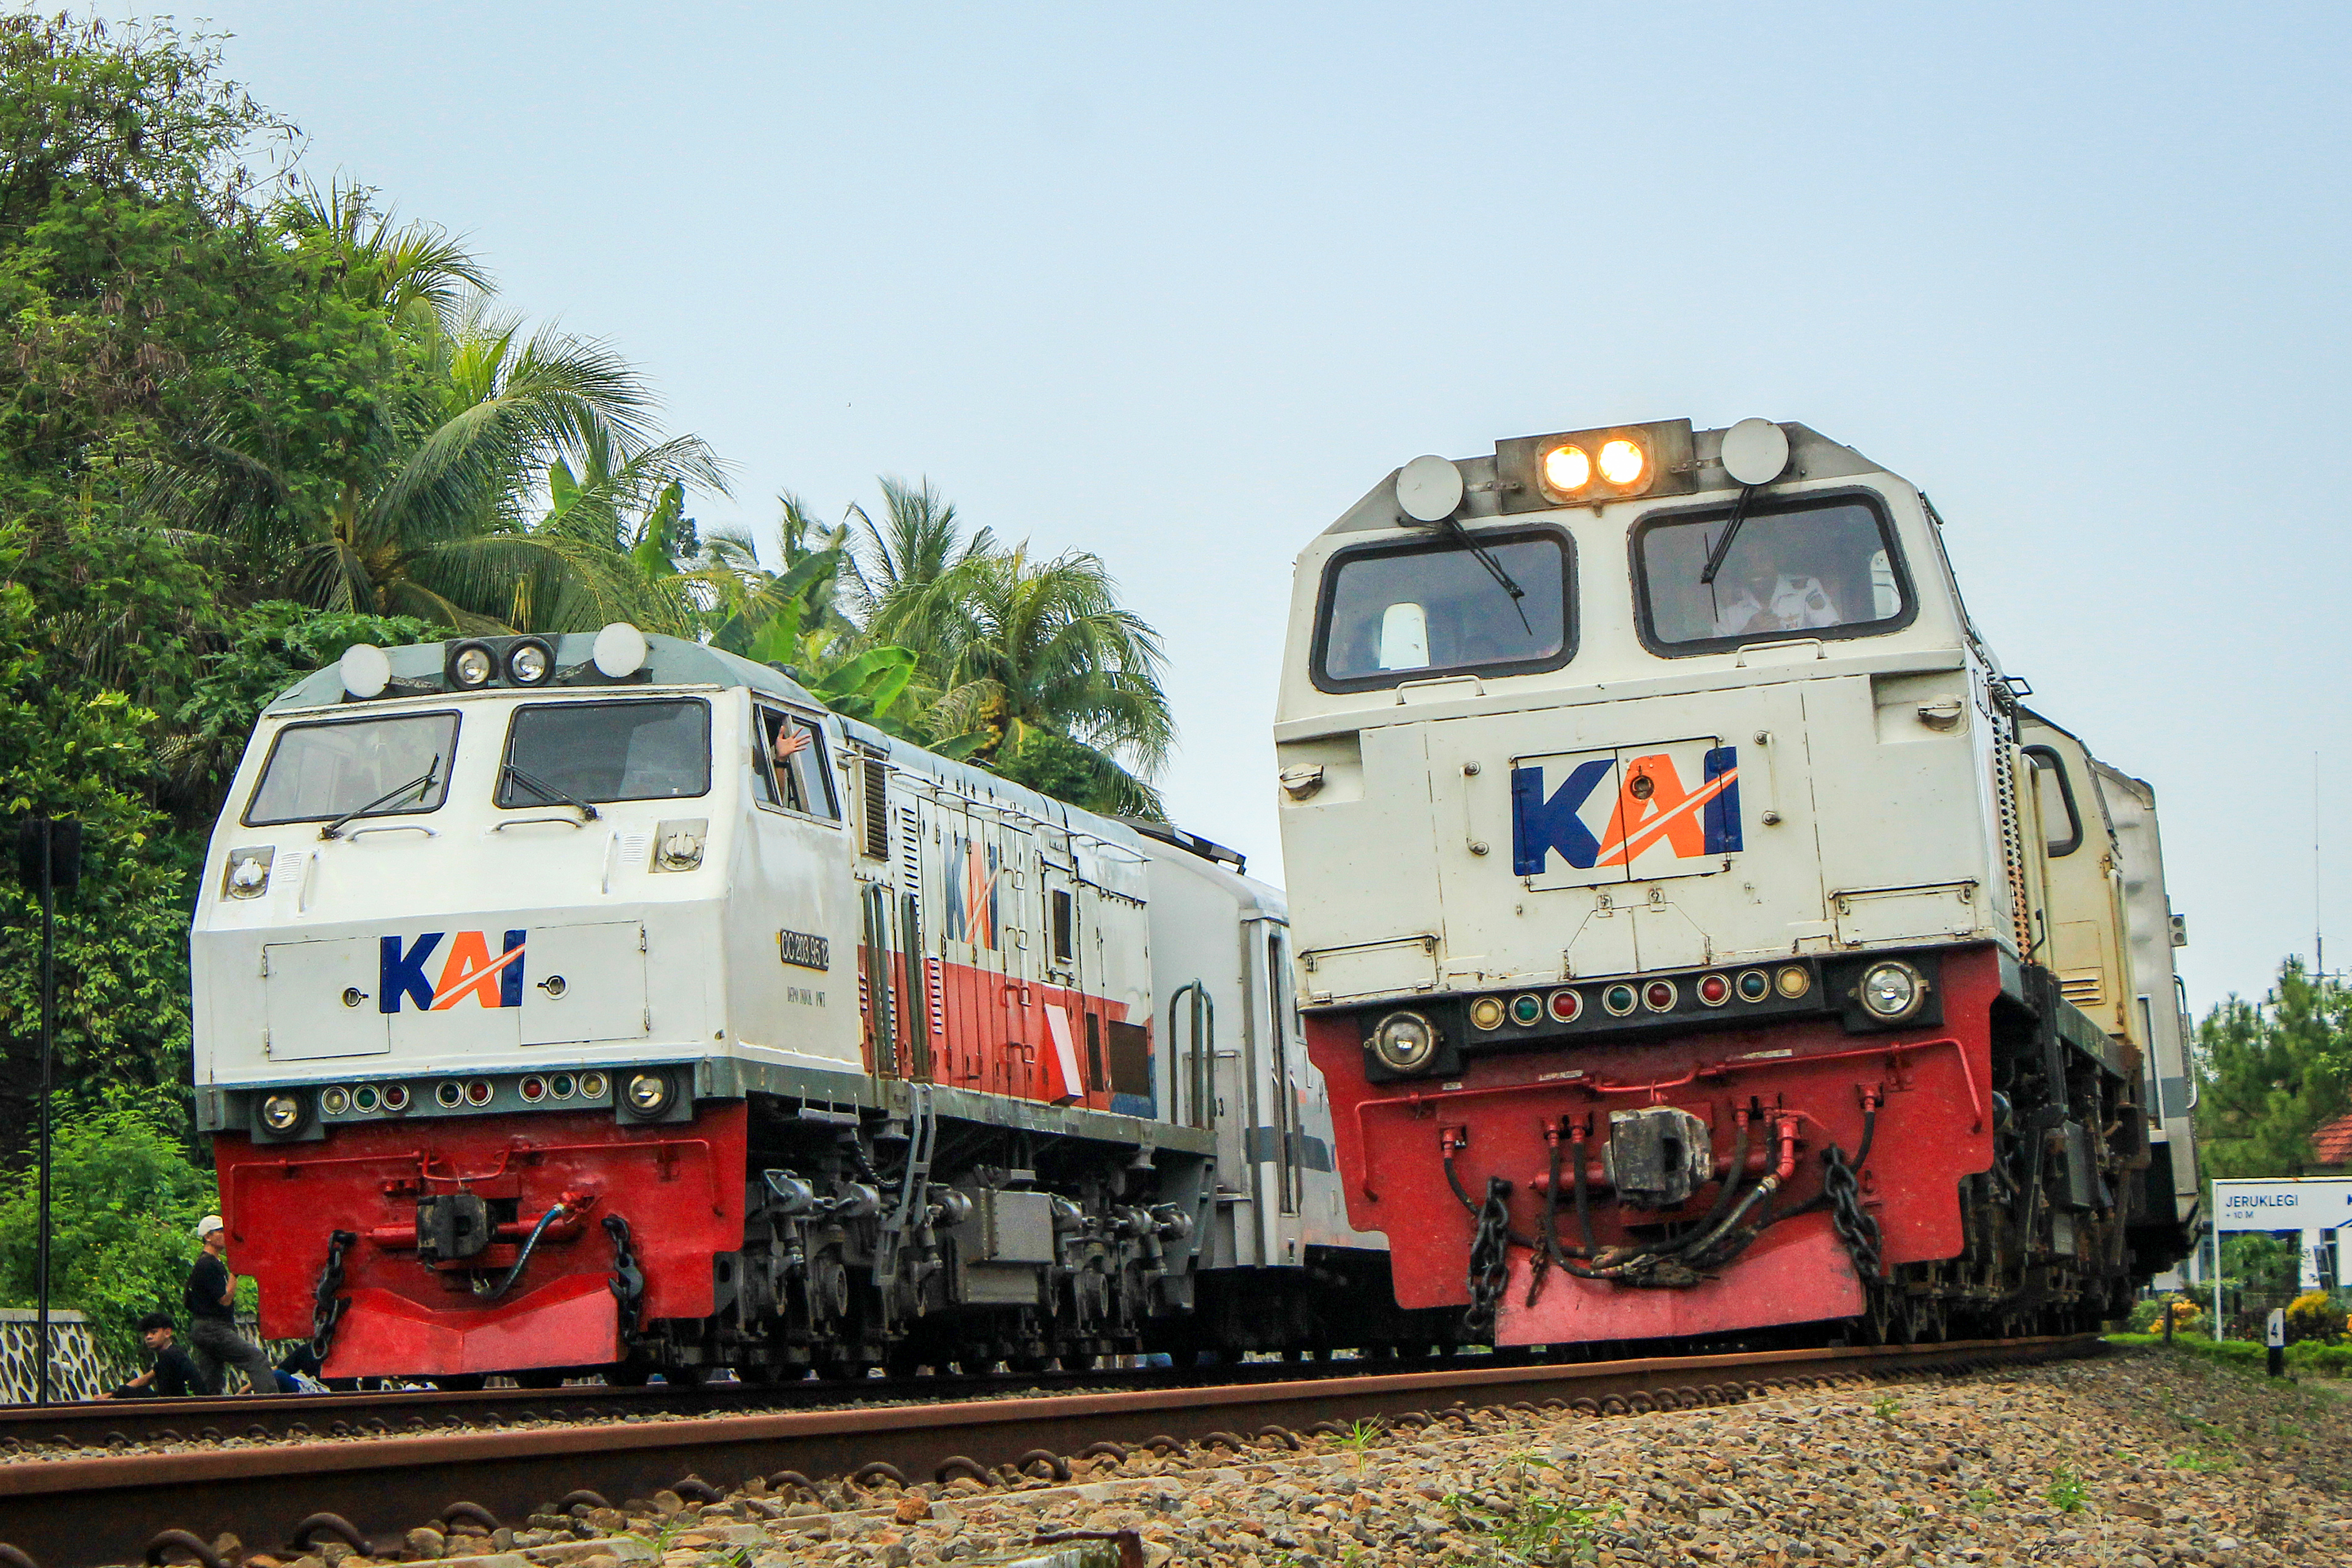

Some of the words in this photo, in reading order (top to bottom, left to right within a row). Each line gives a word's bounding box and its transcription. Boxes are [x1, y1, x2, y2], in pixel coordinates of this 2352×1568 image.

[1511, 746, 1743, 876] KAI
[944, 832, 998, 951] KAI
[380, 930, 527, 1013] KAI
[782, 931, 794, 960] CC
[796, 935, 809, 963] 203
[811, 937, 820, 965] 95
[822, 941, 829, 966] 12
[2226, 1194, 2298, 1207] JERUKLEGI
[2271, 1322, 2278, 1338] 4
